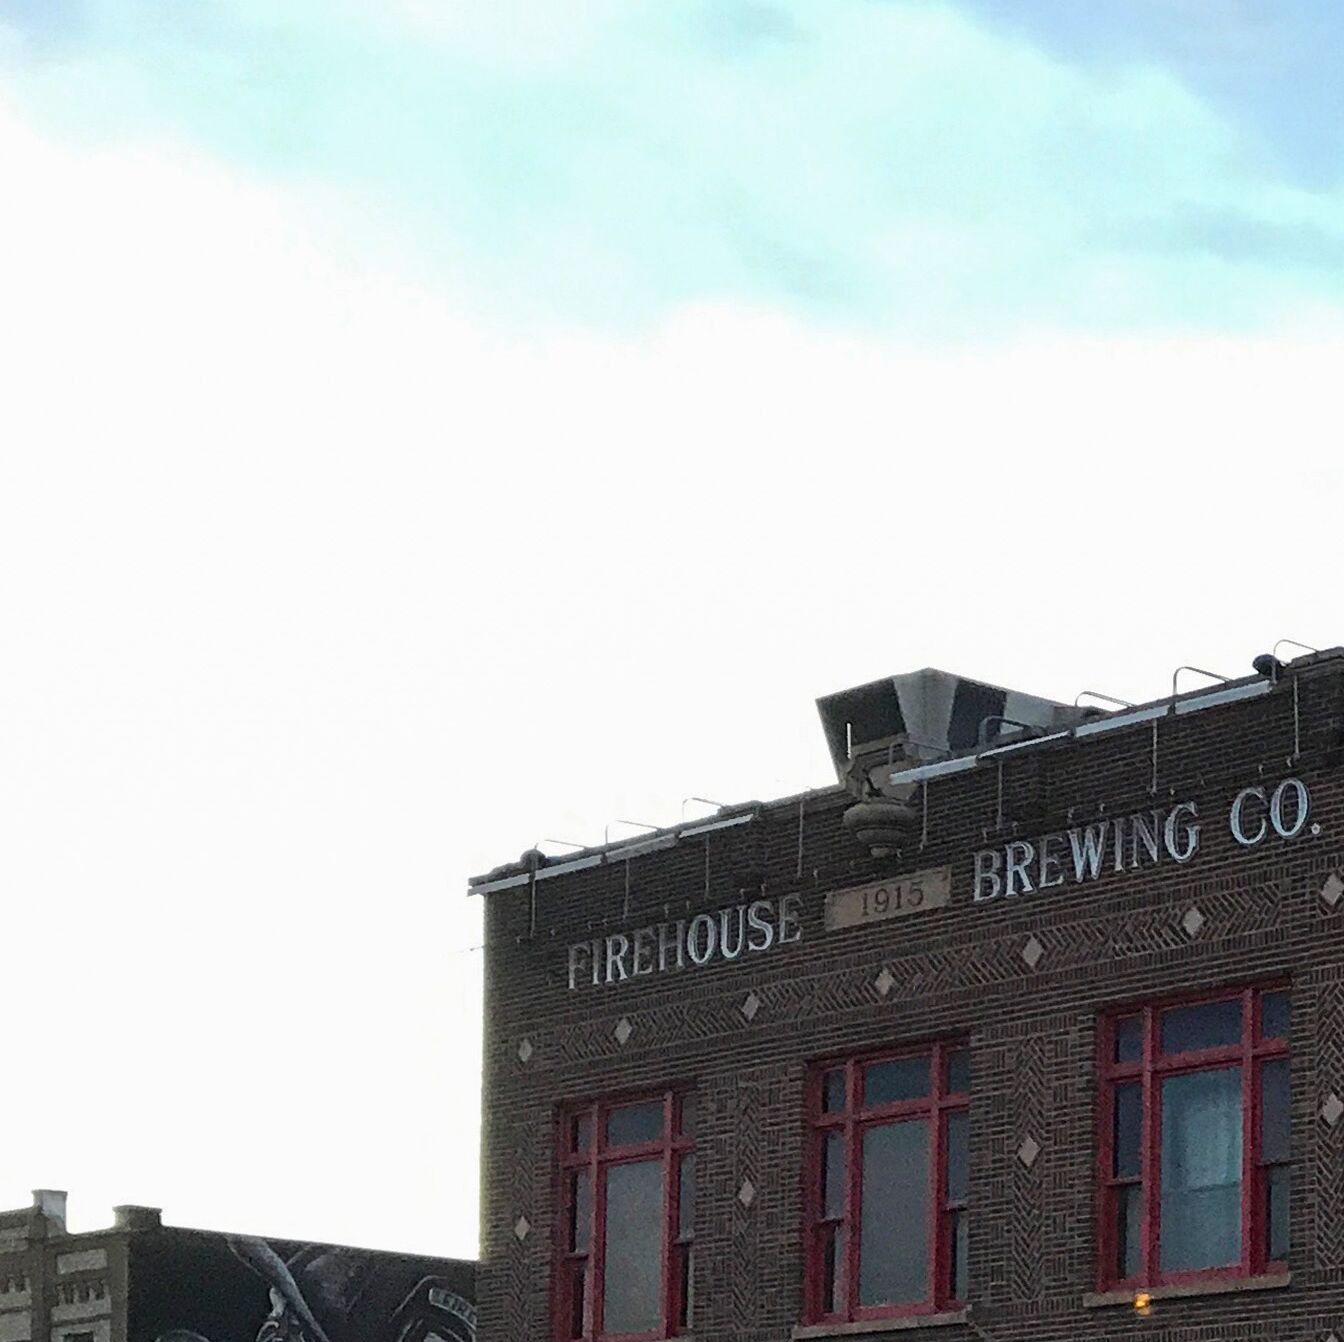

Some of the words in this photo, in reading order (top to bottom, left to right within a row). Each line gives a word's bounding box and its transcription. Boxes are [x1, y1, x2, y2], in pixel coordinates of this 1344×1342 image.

[973, 802, 1199, 903] BREWING
[1229, 778, 1322, 847] CO.
[567, 896, 801, 989] FIREHOUSE
[859, 881, 924, 918] 1915
